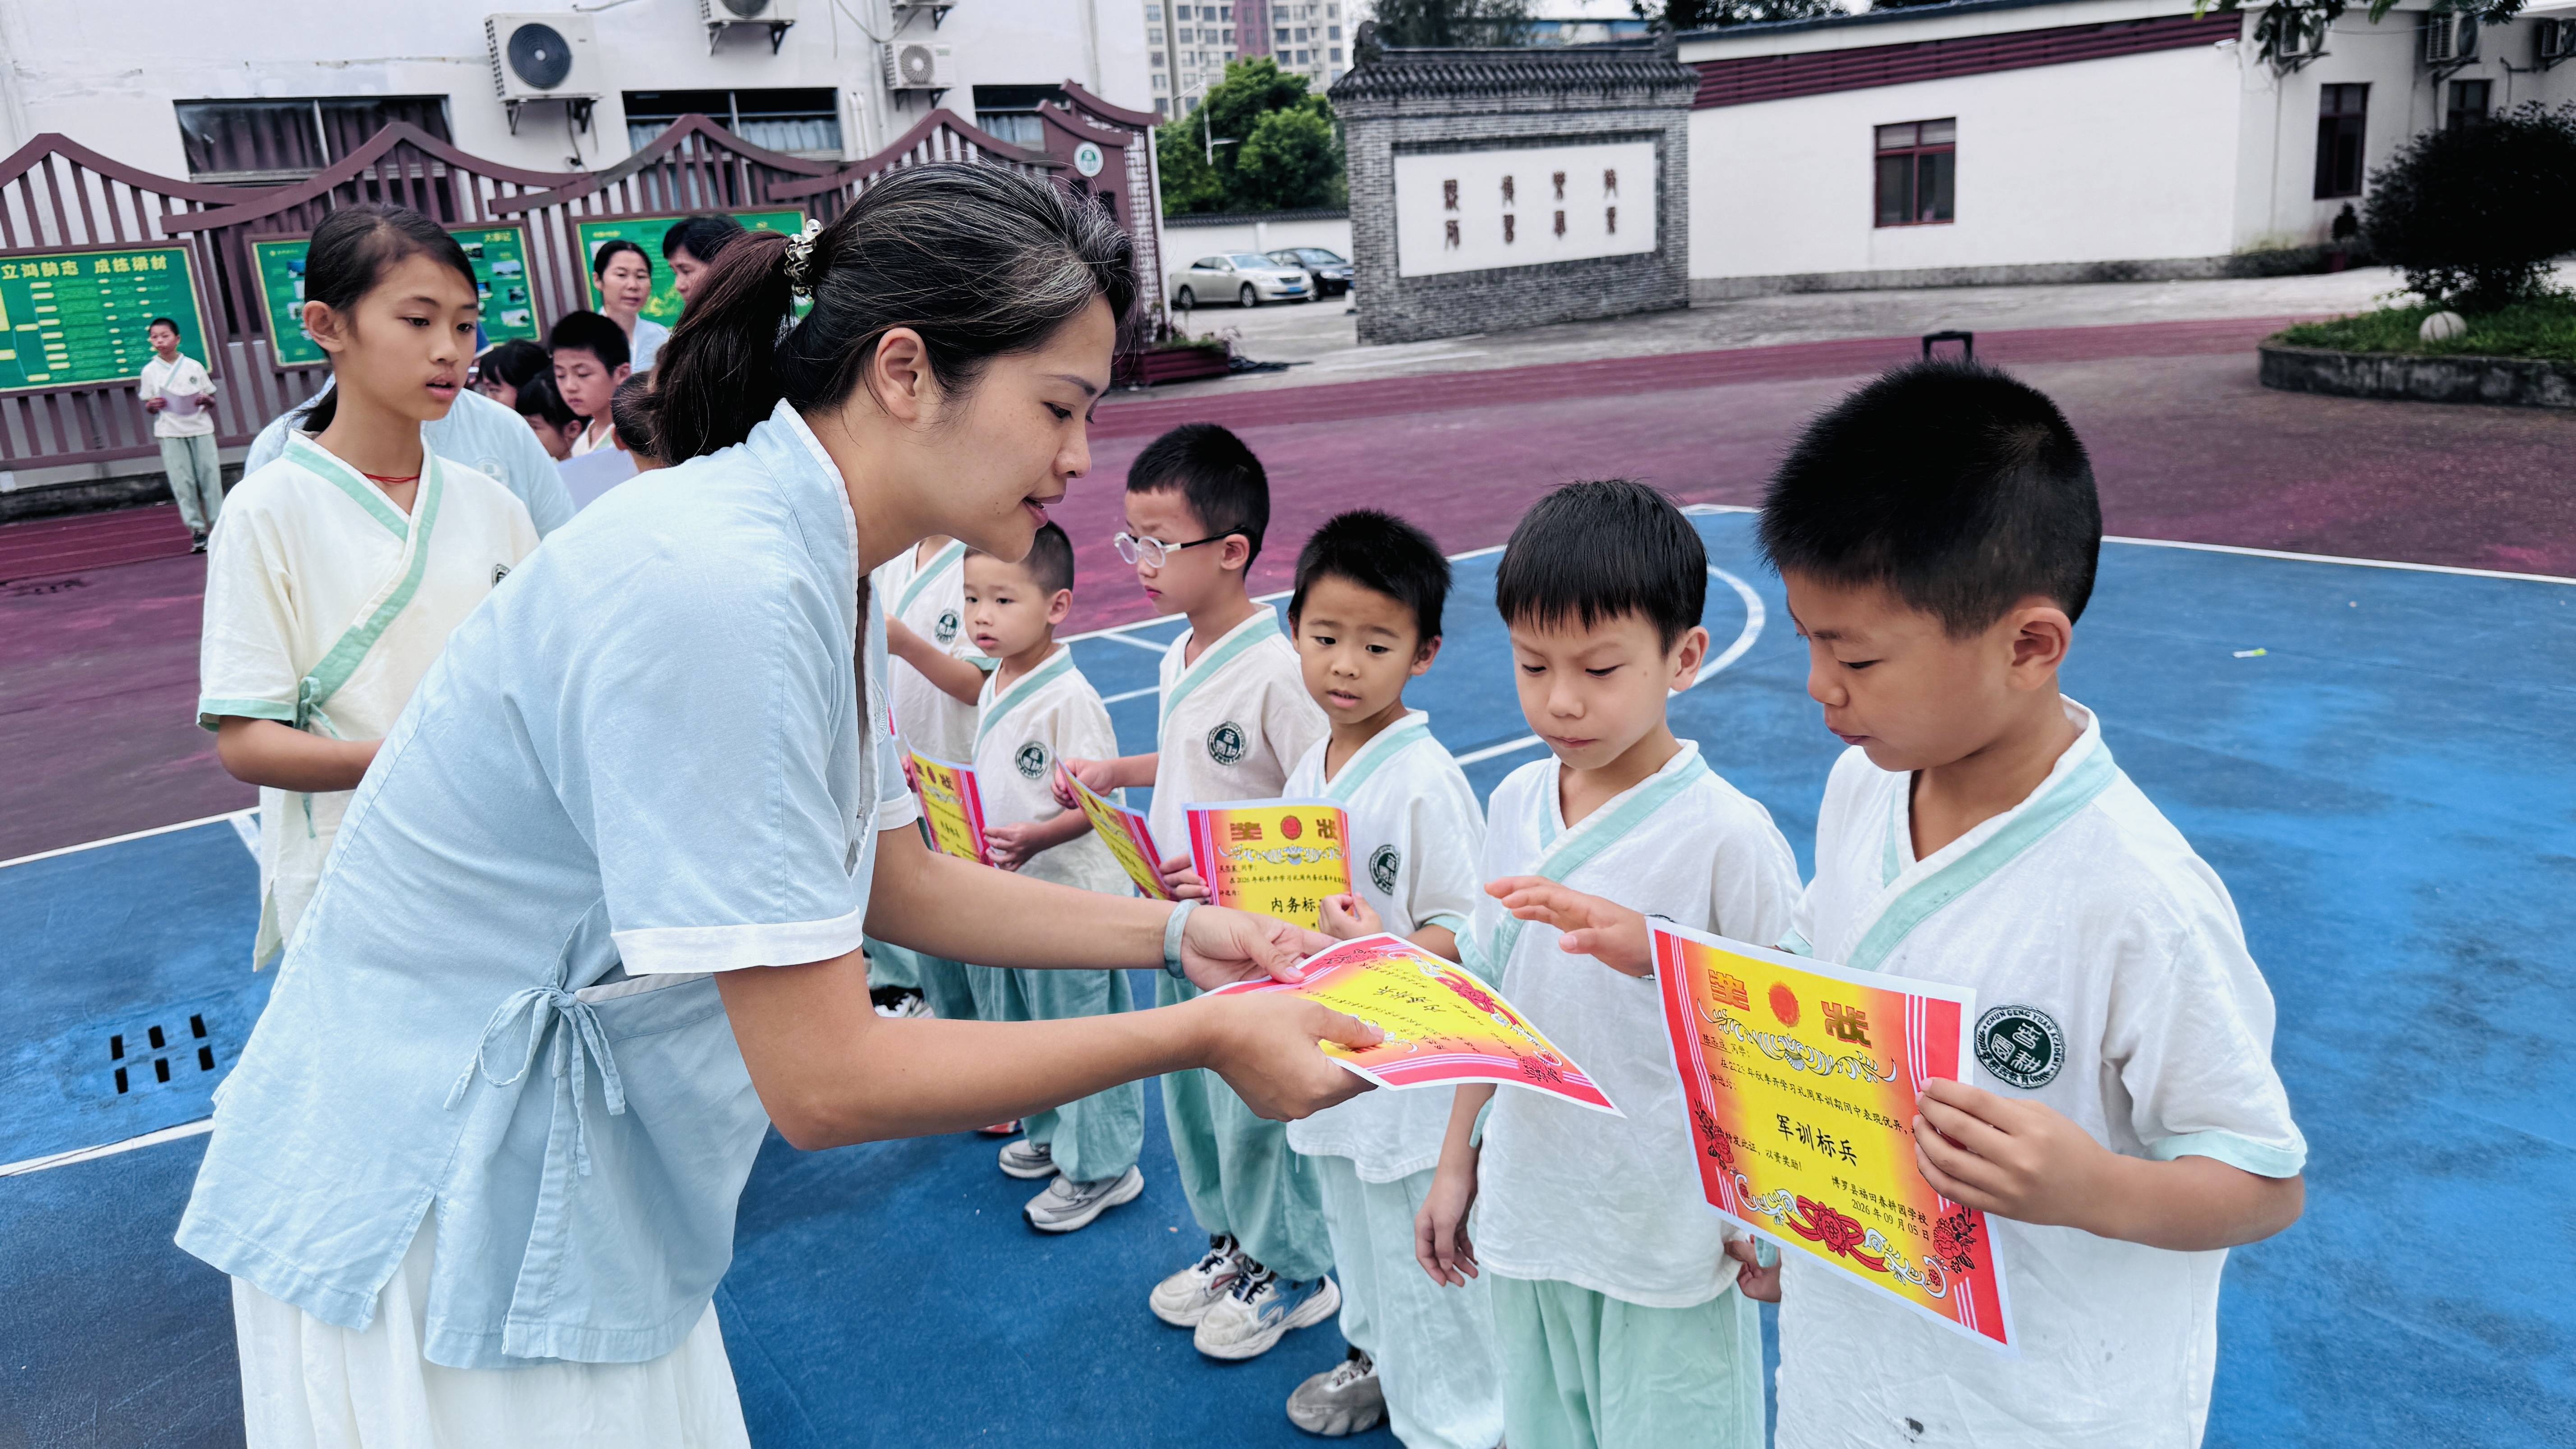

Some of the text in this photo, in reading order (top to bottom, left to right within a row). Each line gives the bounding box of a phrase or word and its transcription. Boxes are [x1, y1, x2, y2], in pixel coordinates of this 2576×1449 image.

[1271, 896, 1322, 914] 内务标
[1821, 1001, 1872, 1049] 状
[1986, 1010, 2006, 1026] CHUN
[2007, 1009, 2031, 1017] GENG
[2033, 1013, 2053, 1031] YUAN
[1776, 1113, 1857, 1167] 军训标兵
[1831, 1175, 1929, 1226] 博罗县福田春耕园学校
